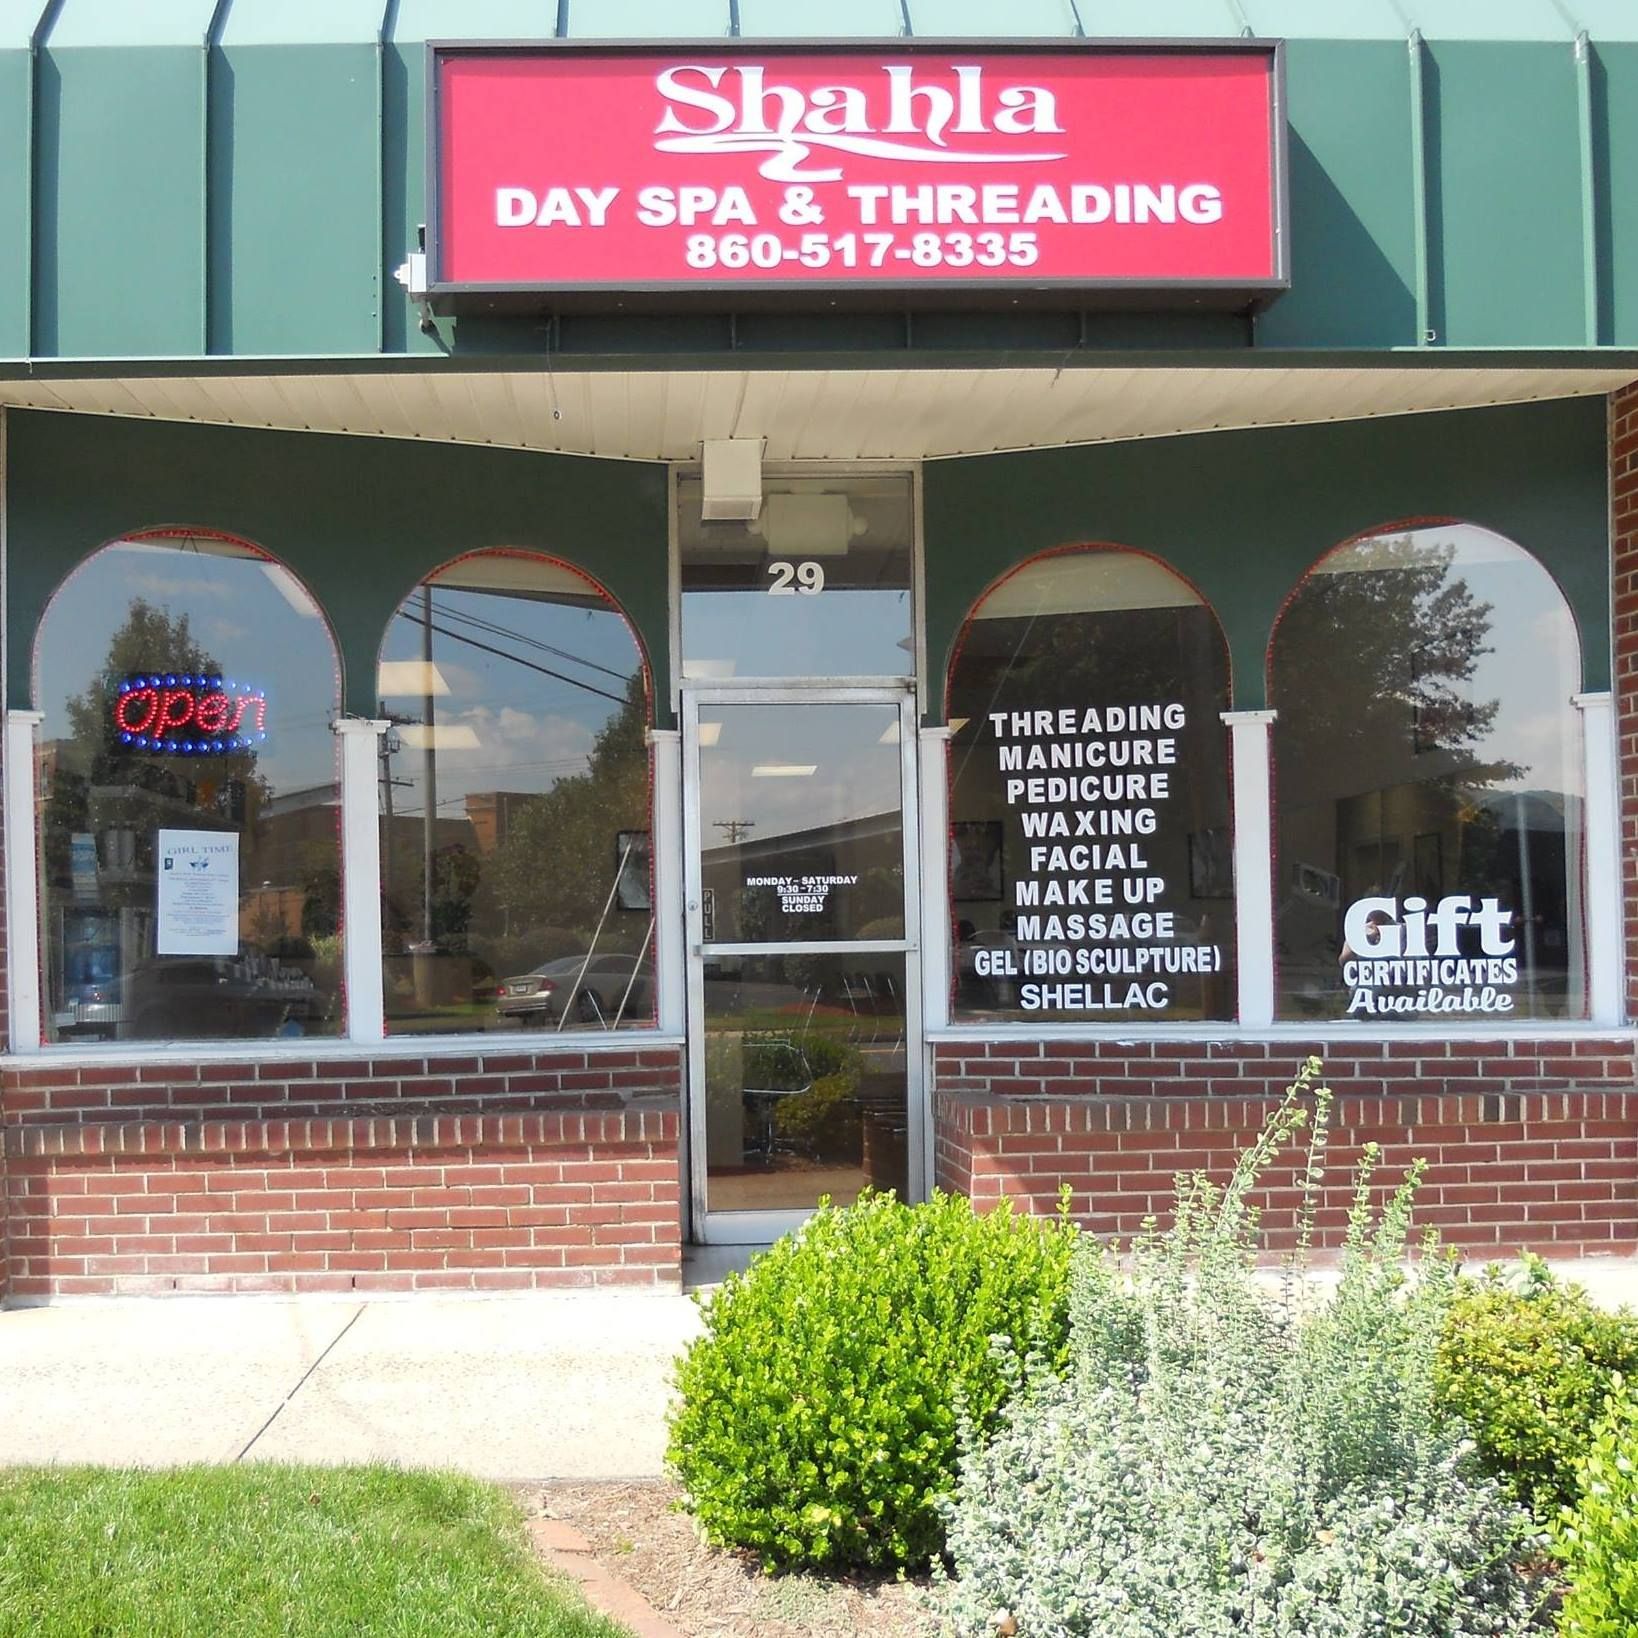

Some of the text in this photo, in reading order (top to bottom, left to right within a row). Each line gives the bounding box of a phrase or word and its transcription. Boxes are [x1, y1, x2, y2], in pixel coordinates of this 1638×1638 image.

[654, 65, 1068, 182] Shahla
[496, 184, 1224, 229] DAY SPA & THREADING
[685, 232, 1039, 269] 860-517-8335
[767, 561, 825, 595] 29
[989, 703, 1185, 737] THREADING
[999, 738, 1176, 770] MANICURE
[1007, 773, 1169, 804] PEDICURE
[1021, 808, 1156, 837] WAXING
[1030, 843, 1147, 871] FACIAL
[782, 896, 825, 904] SUNDAY
[1016, 877, 1165, 906] MAKE UP
[782, 904, 823, 912] CLOSED
[1017, 912, 1174, 940] MASSAGE
[1344, 895, 1516, 958] Gift
[974, 950, 1017, 976] GEL
[1343, 958, 1518, 986] CERTIFICATES
[1020, 982, 1168, 1010] SHELLAC
[1346, 986, 1514, 1013] Available
